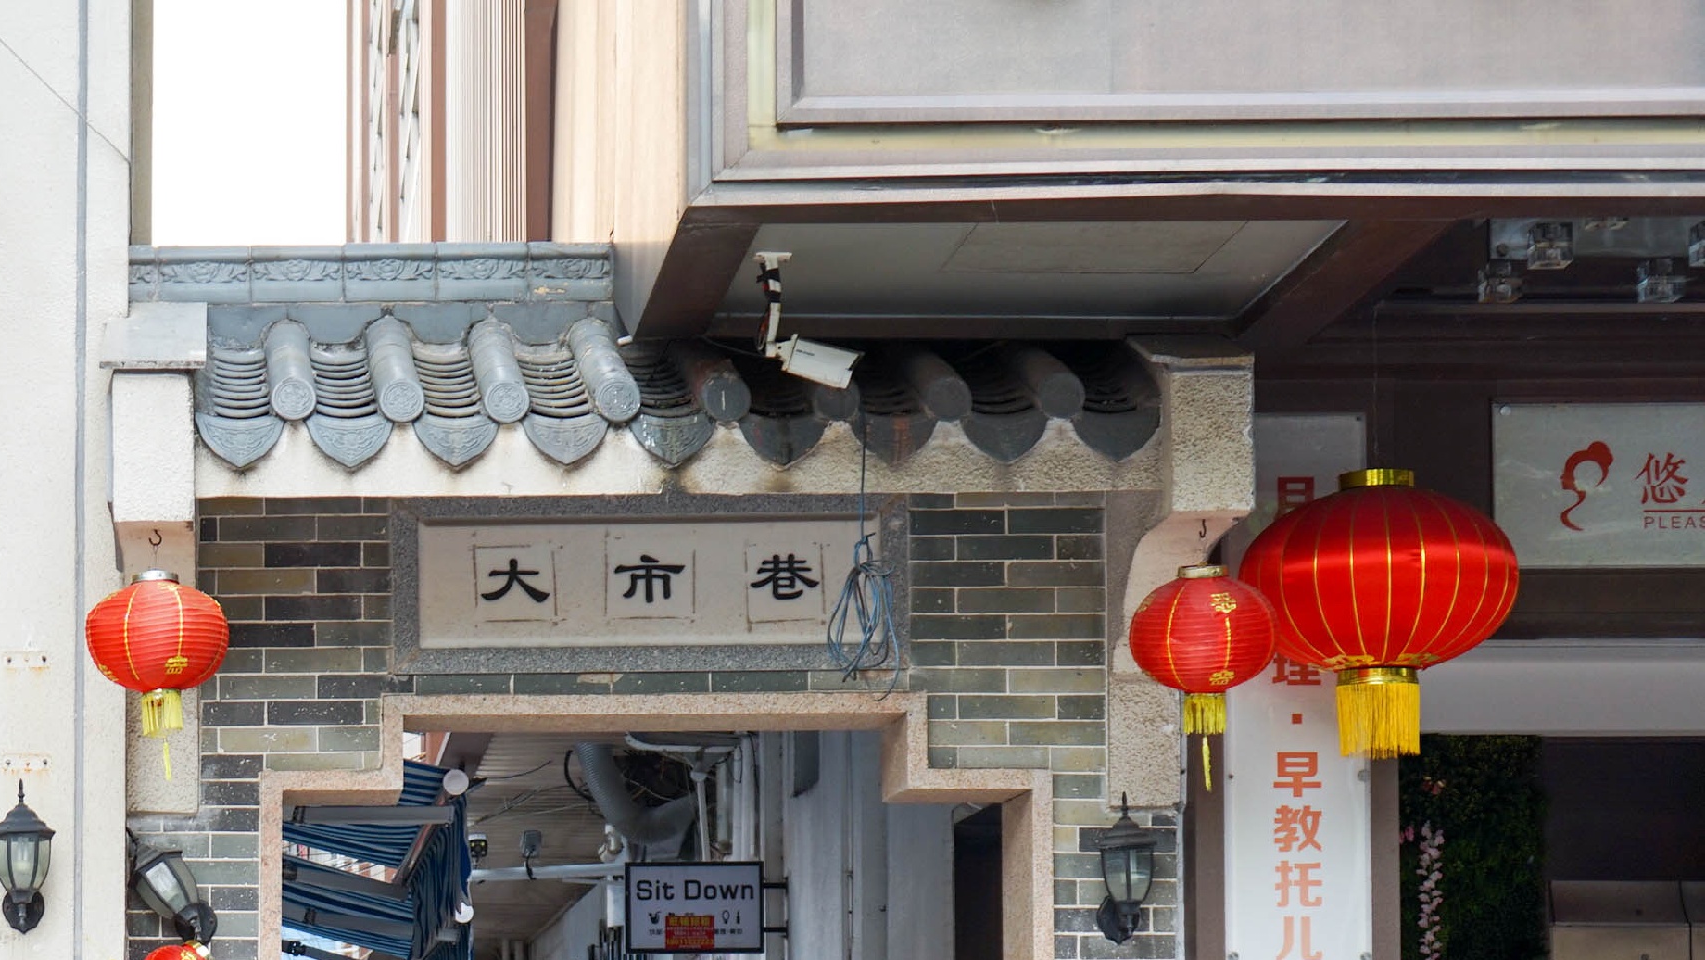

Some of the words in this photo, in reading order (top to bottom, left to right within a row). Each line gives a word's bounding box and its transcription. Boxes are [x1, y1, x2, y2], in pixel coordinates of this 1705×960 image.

[481, 553, 820, 603] 大市巷
[636, 879, 675, 901] Sit
[683, 879, 755, 901] Down
